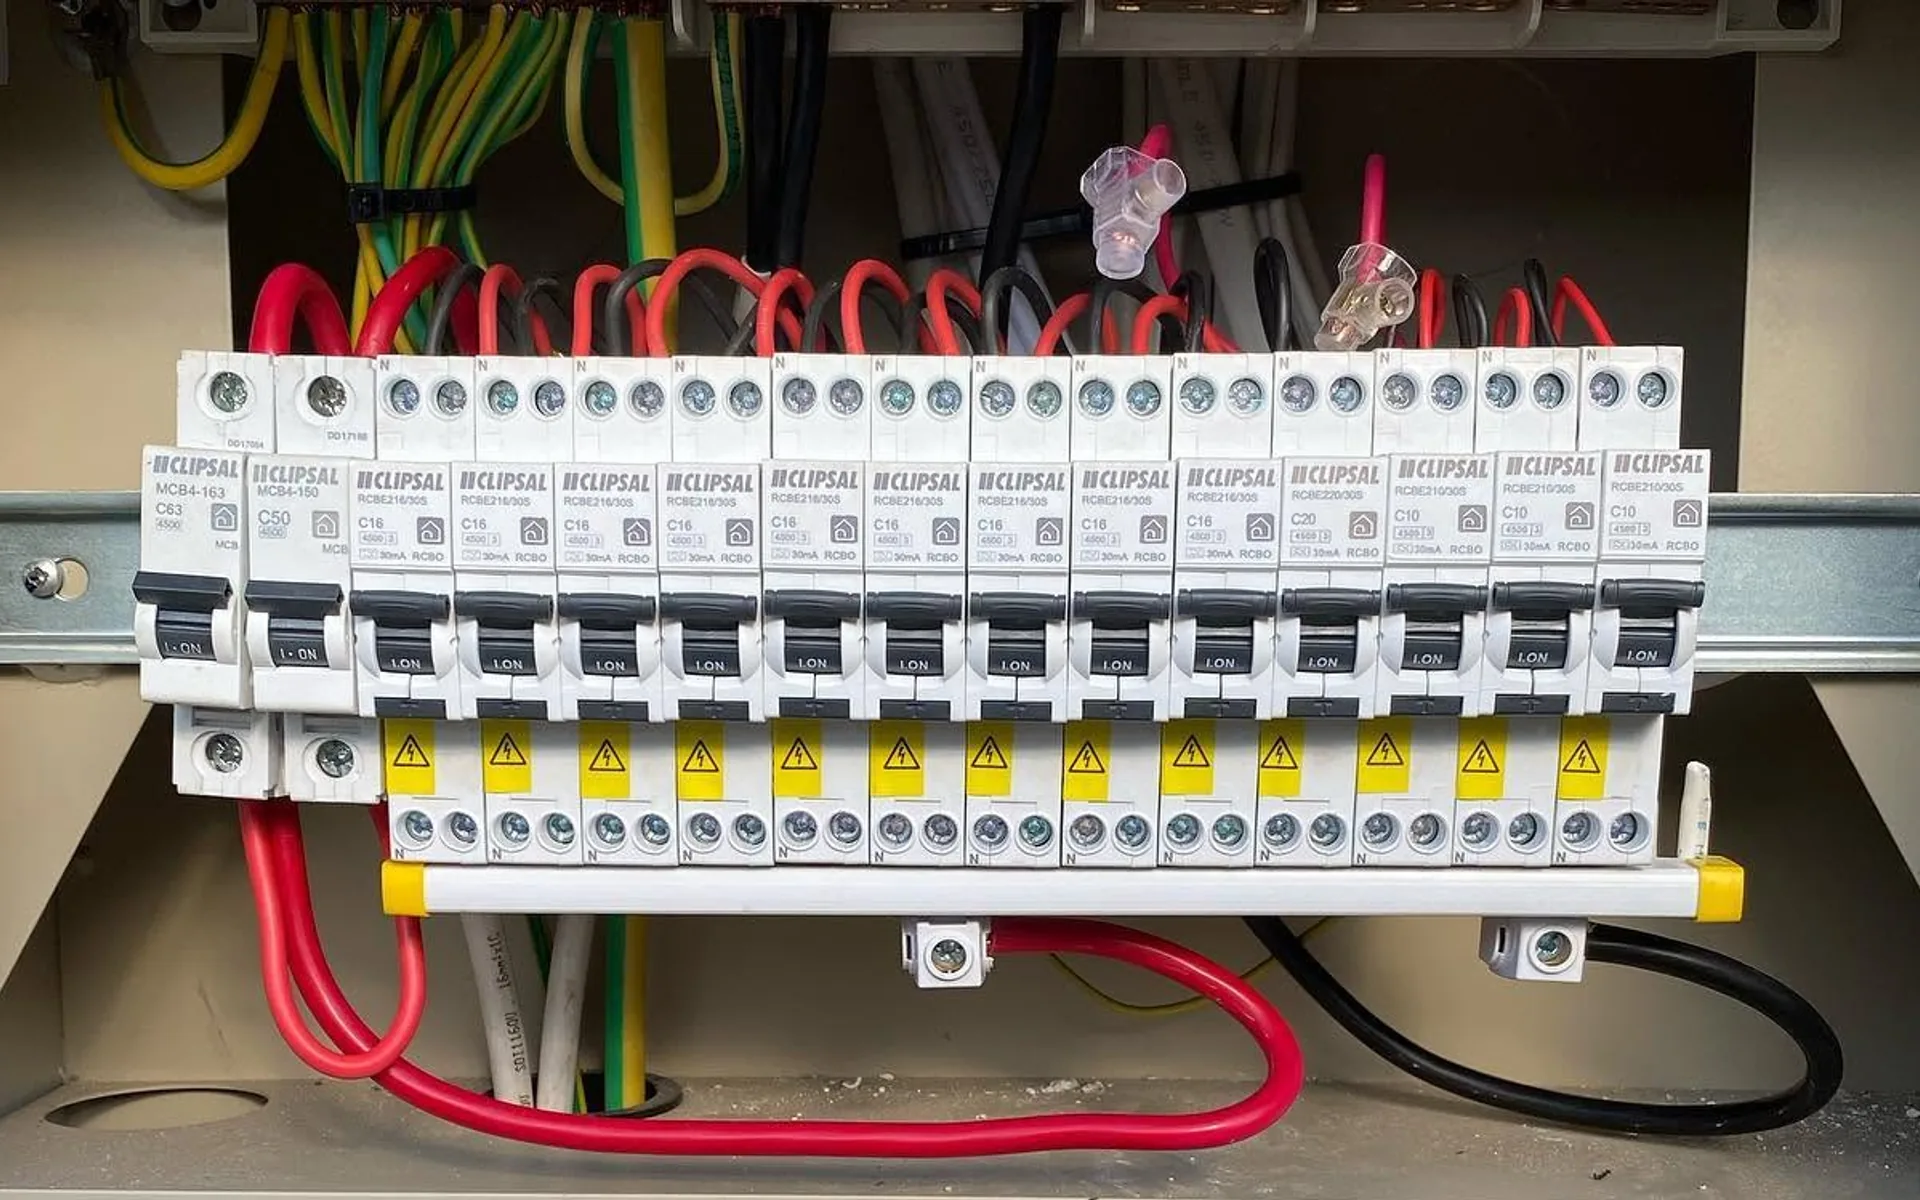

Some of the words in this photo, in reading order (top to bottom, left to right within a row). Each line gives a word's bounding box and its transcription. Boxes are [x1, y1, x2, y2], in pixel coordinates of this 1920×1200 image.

[1380, 352, 1389, 363] N
[1483, 351, 1492, 362] N
[1587, 350, 1597, 360] N
[380, 360, 389, 370] N
[478, 360, 487, 370] N
[577, 361, 586, 371] N
[675, 361, 684, 371] N
[776, 358, 784, 368] N
[876, 360, 885, 371] N
[976, 361, 985, 372] N
[1076, 361, 1085, 371] N
[1178, 358, 1187, 369] N
[1280, 357, 1289, 368] N
[170, 456, 238, 478] CLIPSAL
[1415, 459, 1488, 478] CLIPSAL
[1523, 457, 1595, 476] CLIPSAL
[1631, 454, 1704, 473] CLIPSAL
[269, 466, 339, 487] CLIPSAL
[787, 469, 858, 489] CLIPSAL
[1098, 470, 1169, 489] CLIPSAL
[1203, 468, 1275, 487] CLIPSAL
[1308, 465, 1379, 484] CLIPSAL
[374, 471, 444, 491] CLIPSAL
[476, 472, 547, 491] CLIPSAL
[579, 473, 650, 492] CLIPSAL
[682, 473, 753, 492] CLIPSAL
[889, 472, 960, 491] CLIPSAL
[993, 472, 1065, 491] CLIPSAL
[156, 482, 225, 499] MCB4-163
[257, 485, 319, 498] MCB4-150
[156, 502, 184, 516] C63
[258, 510, 291, 527] C50
[215, 540, 239, 550] MCB
[322, 544, 348, 554] MCB
[1450, 544, 1483, 554] RCBO
[1557, 542, 1590, 552] RCBO
[1666, 541, 1699, 551] RCBO
[412, 551, 444, 562] RCBO
[515, 552, 547, 562] RCBO
[824, 550, 856, 560] RCBO
[927, 552, 960, 562] RCBO
[1030, 553, 1063, 563] RCBO
[1134, 552, 1166, 561] RCBO
[1239, 549, 1272, 559] RCBO
[1347, 548, 1379, 557] RCBO
[618, 554, 652, 564] RCBO
[721, 553, 753, 564] RCBO
[395, 848, 404, 859] N
[492, 848, 502, 860] N
[588, 849, 596, 861] N
[683, 849, 692, 861] N
[779, 847, 787, 858] N
[875, 851, 883, 862] N
[1164, 852, 1173, 862] N
[1260, 850, 1269, 861] N
[1455, 852, 1464, 862] N
[1557, 851, 1565, 862] N
[970, 853, 979, 864] N
[1067, 853, 1076, 864] N
[1357, 853, 1366, 864] N
